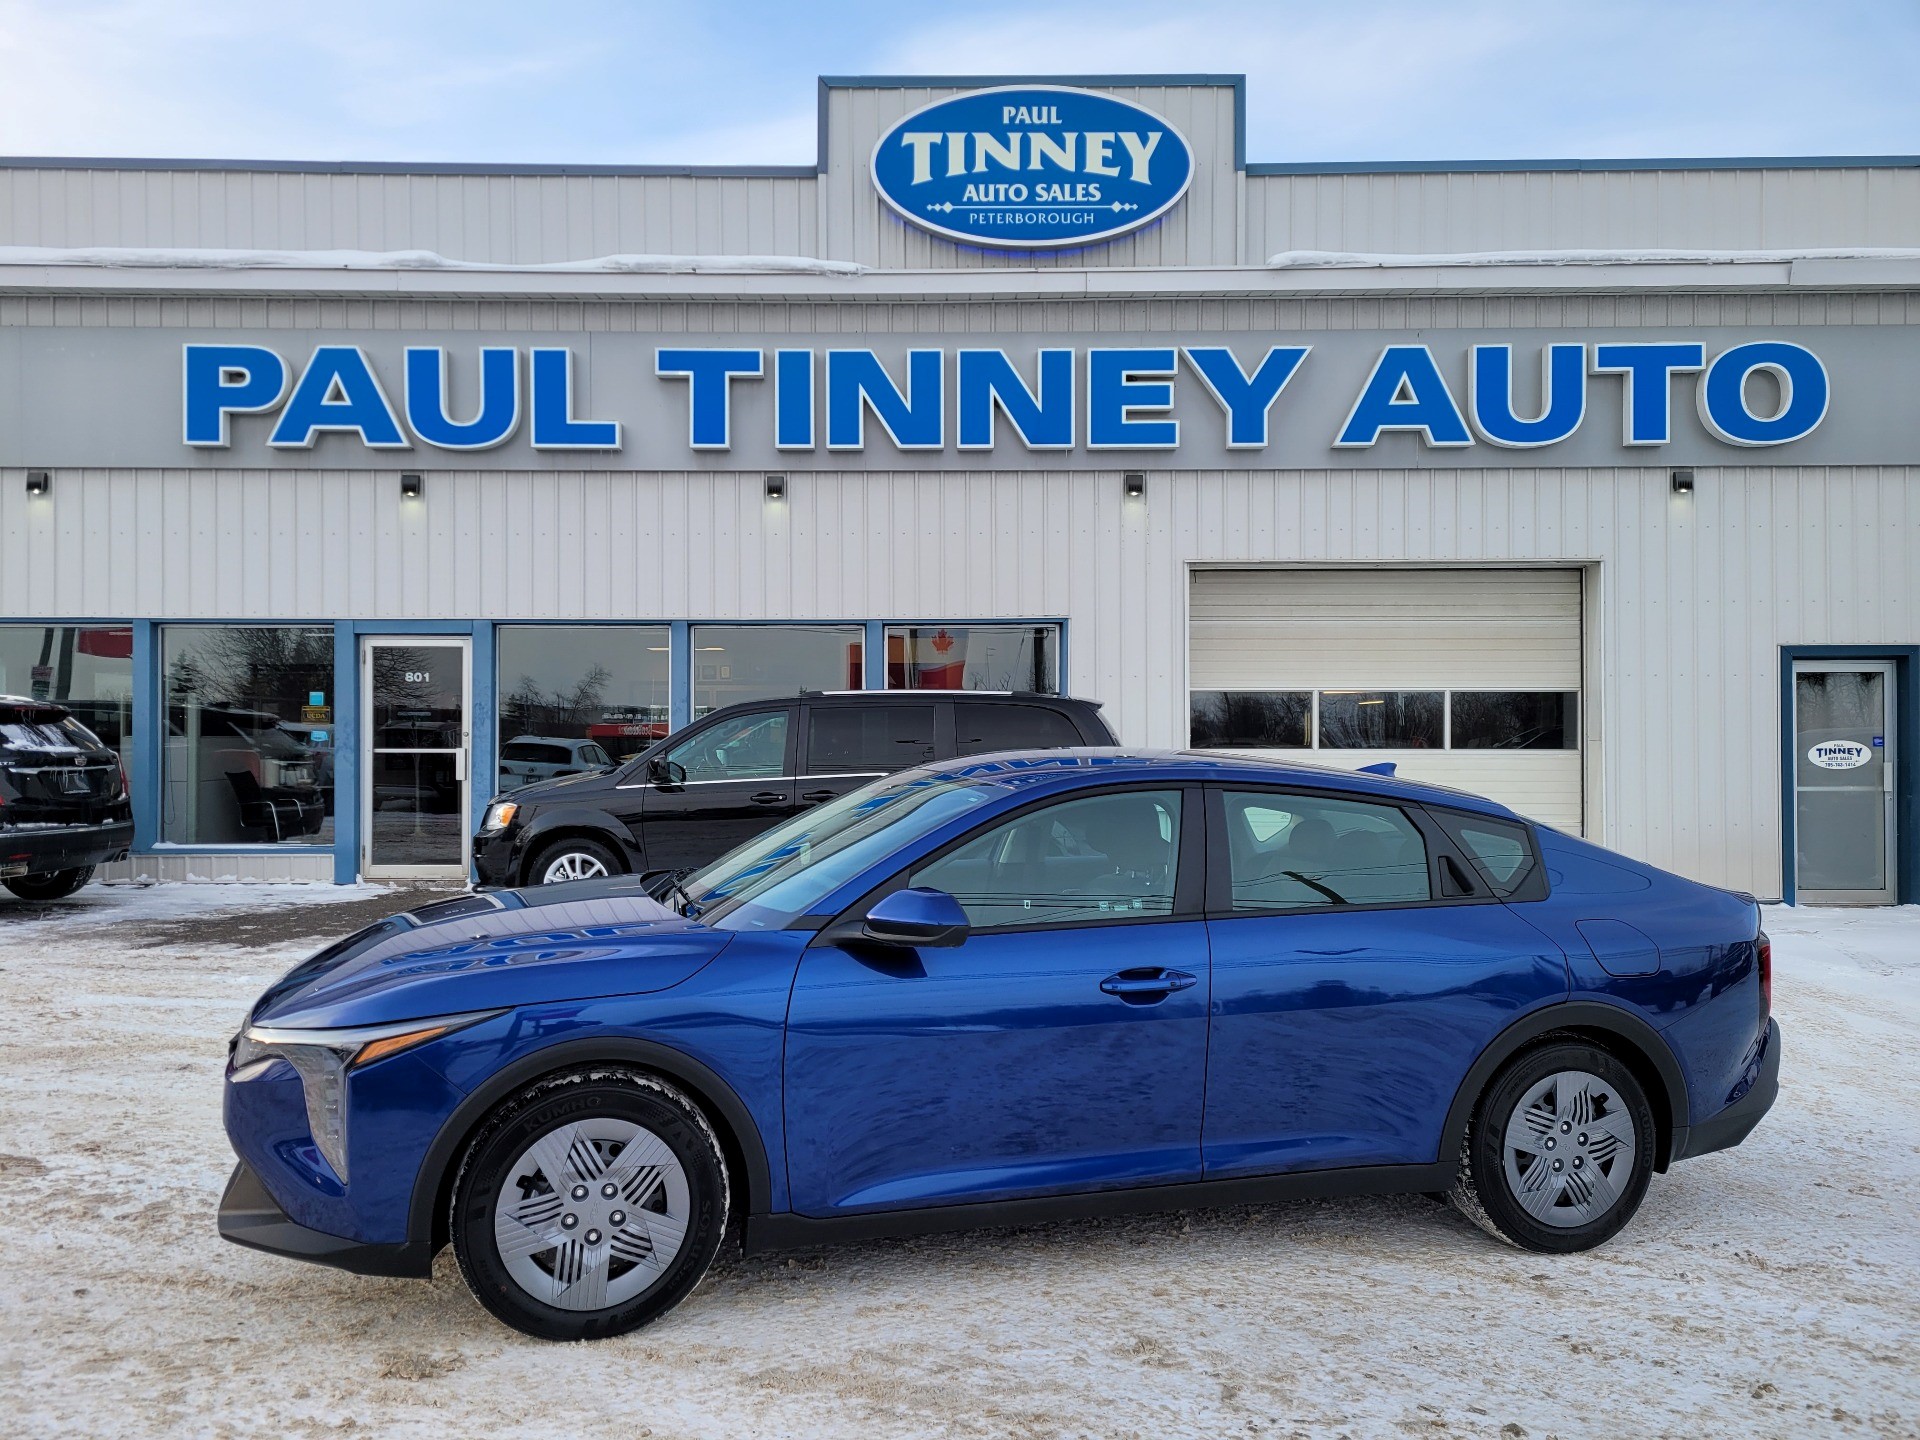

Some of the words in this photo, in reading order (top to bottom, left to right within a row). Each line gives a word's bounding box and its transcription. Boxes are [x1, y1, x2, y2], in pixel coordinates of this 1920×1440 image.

[1002, 106, 1063, 124] PAUL
[901, 131, 1164, 186] TINNEY
[962, 183, 1029, 202] AUTO
[1035, 183, 1102, 202] SALES
[969, 212, 1095, 225] PETERBOROUGH
[182, 343, 623, 452] PAUL
[654, 345, 1313, 452] TINNEY
[1331, 340, 1831, 449] AUTO
[404, 672, 430, 683] 801
[1816, 747, 1863, 758] TINNEY
[524, 1096, 602, 1134] KUMHO
